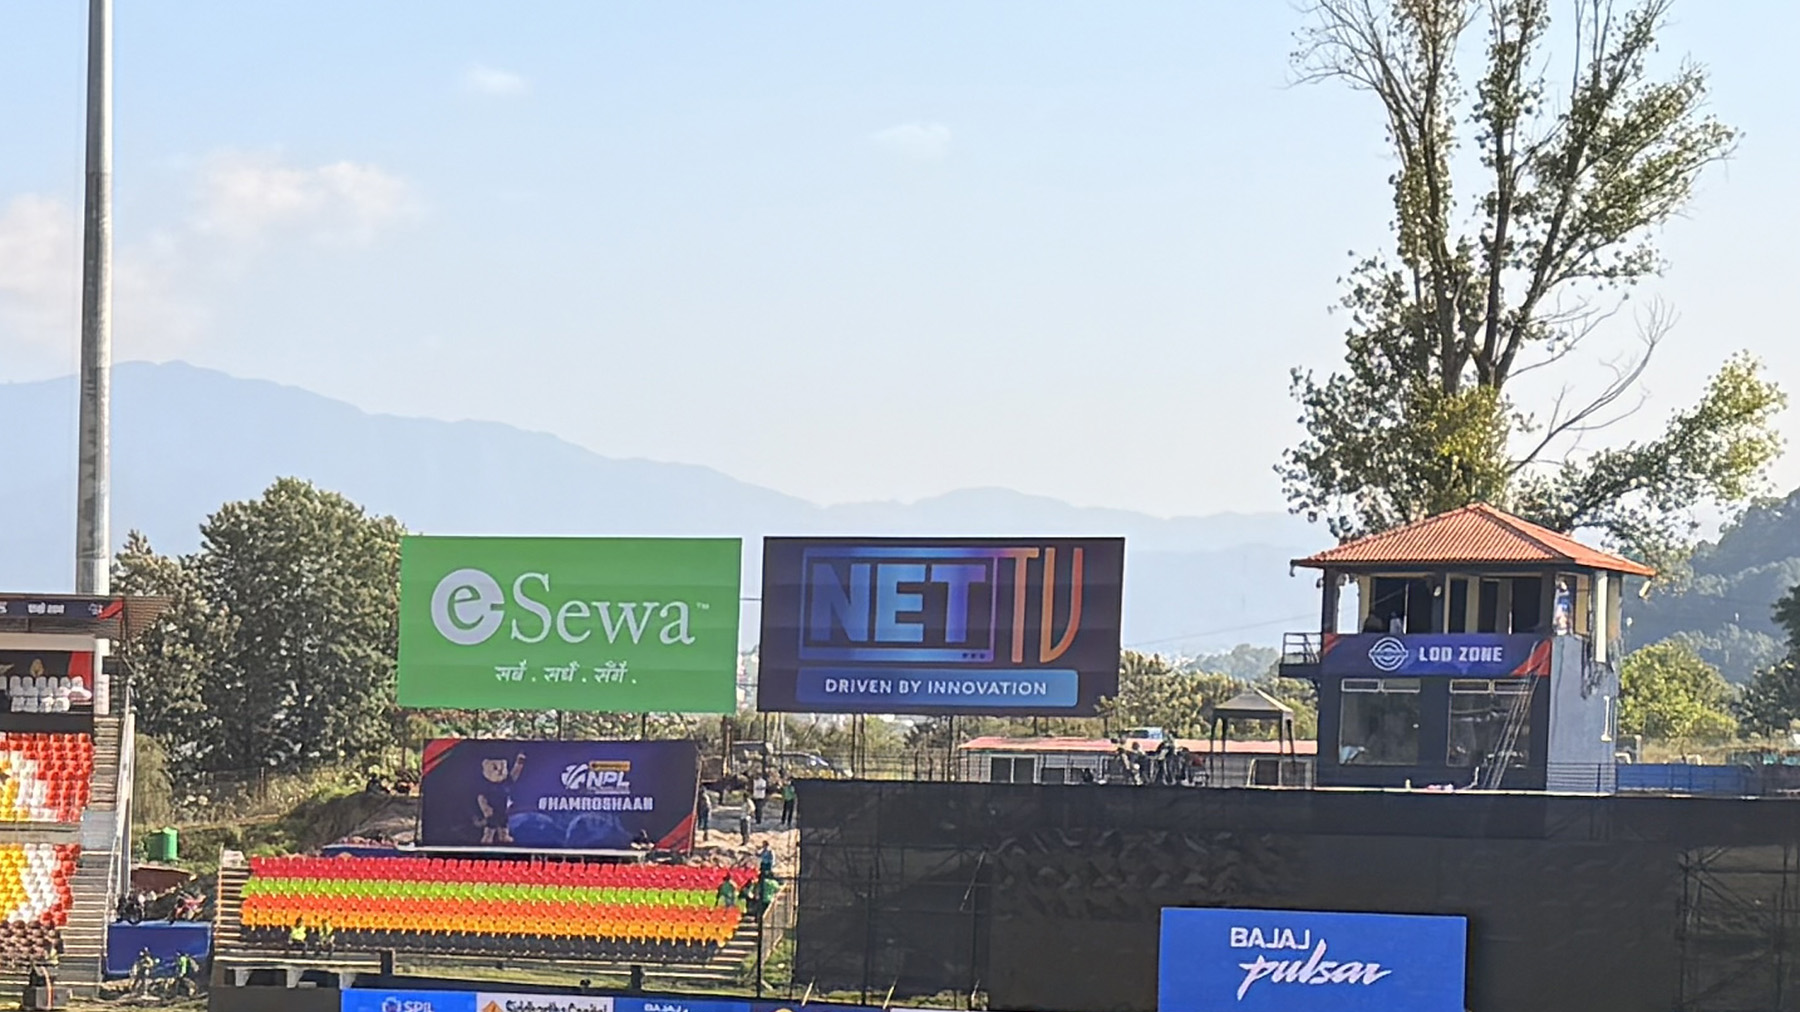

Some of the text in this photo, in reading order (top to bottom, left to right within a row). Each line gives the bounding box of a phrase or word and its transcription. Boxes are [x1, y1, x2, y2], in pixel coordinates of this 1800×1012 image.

[430, 567, 697, 646] eSewa
[809, 546, 1084, 664] NET TV
[1418, 645, 1504, 663] LOD ZONE
[824, 677, 1048, 696] DRIVEN BY INNOVATION
[586, 770, 631, 788] NPL
[1230, 926, 1311, 950] BAJAJ
[1236, 937, 1393, 1002] pulsar
